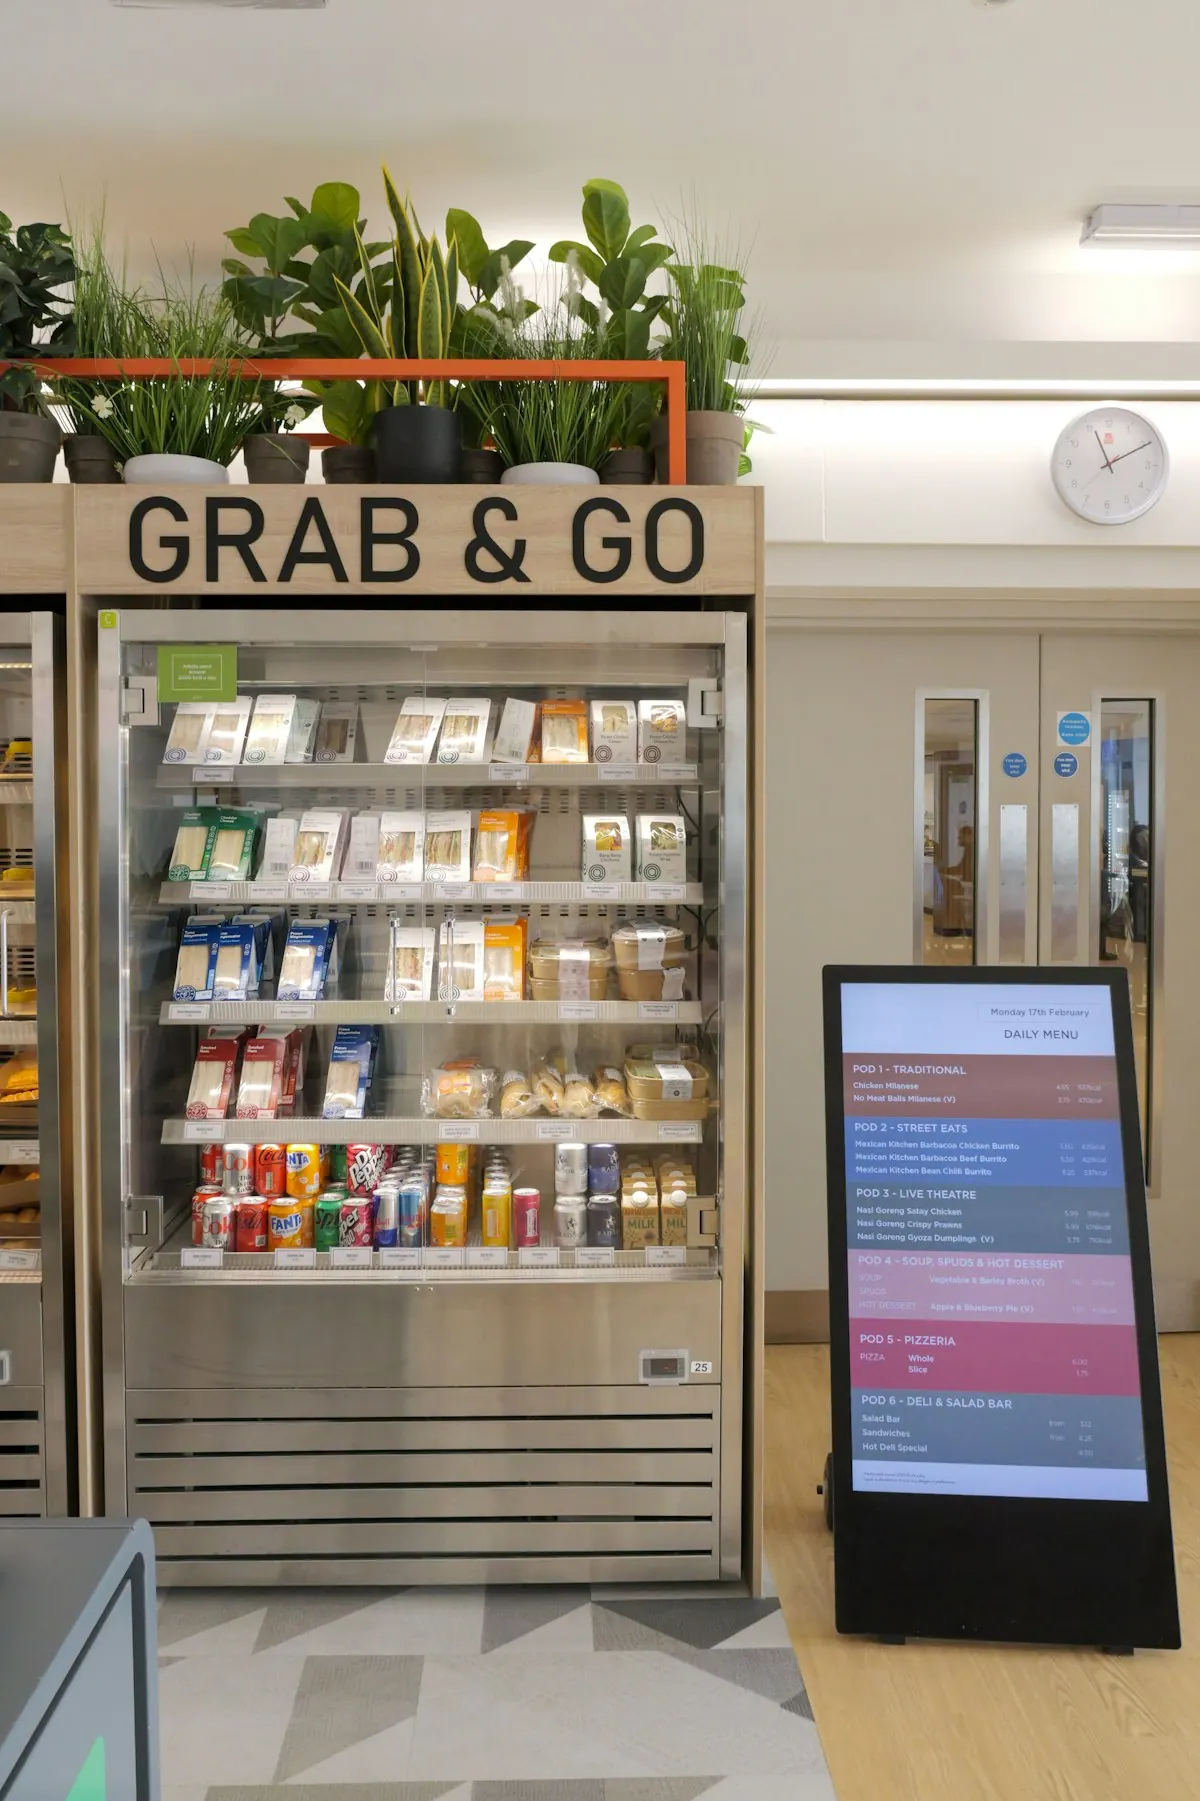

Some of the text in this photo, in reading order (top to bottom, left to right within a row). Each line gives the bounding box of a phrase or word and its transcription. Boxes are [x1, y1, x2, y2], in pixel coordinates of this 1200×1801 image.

[1070, 440, 1079, 448] 10
[1066, 460, 1072, 468] 9
[1145, 460, 1150, 470] 3
[1072, 480, 1077, 488] 8
[1084, 494, 1089, 502] 7
[1124, 495, 1129, 504] 5
[1104, 500, 1110, 509] 6
[130, 496, 703, 583] GRAB & GO
[990, 1008, 1089, 1018] Monday 17th February
[1004, 1030, 1079, 1039] DAILY MENU
[853, 1065, 966, 1075] POD 1 TRADITIONAL
[885, 1082, 919, 1090] Milanese
[943, 1095, 956, 1104] (V)
[854, 1123, 968, 1133] POD 2 STREET EATS
[855, 1140, 886, 1148] Mexican
[855, 1153, 887, 1161] Mexican
[980, 1155, 1007, 1163] Burrito
[856, 1166, 887, 1174] Mexican
[856, 1189, 977, 1200] POD 3 LIVE THEATRE
[857, 1206, 873, 1214] Nasi
[876, 1207, 904, 1216] Goreng
[906, 1208, 928, 1216] Satay
[628, 1219, 654, 1229] MILK
[667, 1219, 687, 1228] MIL
[876, 1220, 905, 1229] Goreng
[907, 1221, 932, 1229] Crispy
[934, 1221, 962, 1229] Prawns
[857, 1232, 995, 1244] Nasi Goreng Gyoza Dumplings (V)
[858, 1256, 1064, 1269] POD 4 SOUP, SPUDS & HOT DESSERT
[929, 1275, 969, 1284] Vegetable
[979, 1278, 1004, 1286] Barley
[1007, 1277, 1030, 1286] Broth
[1031, 1278, 1045, 1287] (V)
[859, 1301, 917, 1310] HOT DESSERT
[930, 1303, 954, 1312] Apple
[964, 1304, 1002, 1312] Blueberry
[1020, 1304, 1033, 1314] (V)
[860, 1334, 956, 1346] POD 5 PIZZERIA
[860, 1353, 885, 1361] PIZZA
[695, 1363, 708, 1372] 25
[861, 1396, 1013, 1409] POD 6 DELI & SALAD BAR
[861, 1414, 884, 1422] Salad
[862, 1429, 910, 1437] Sandwiches
[863, 1442, 928, 1453] Hot Deli Special
